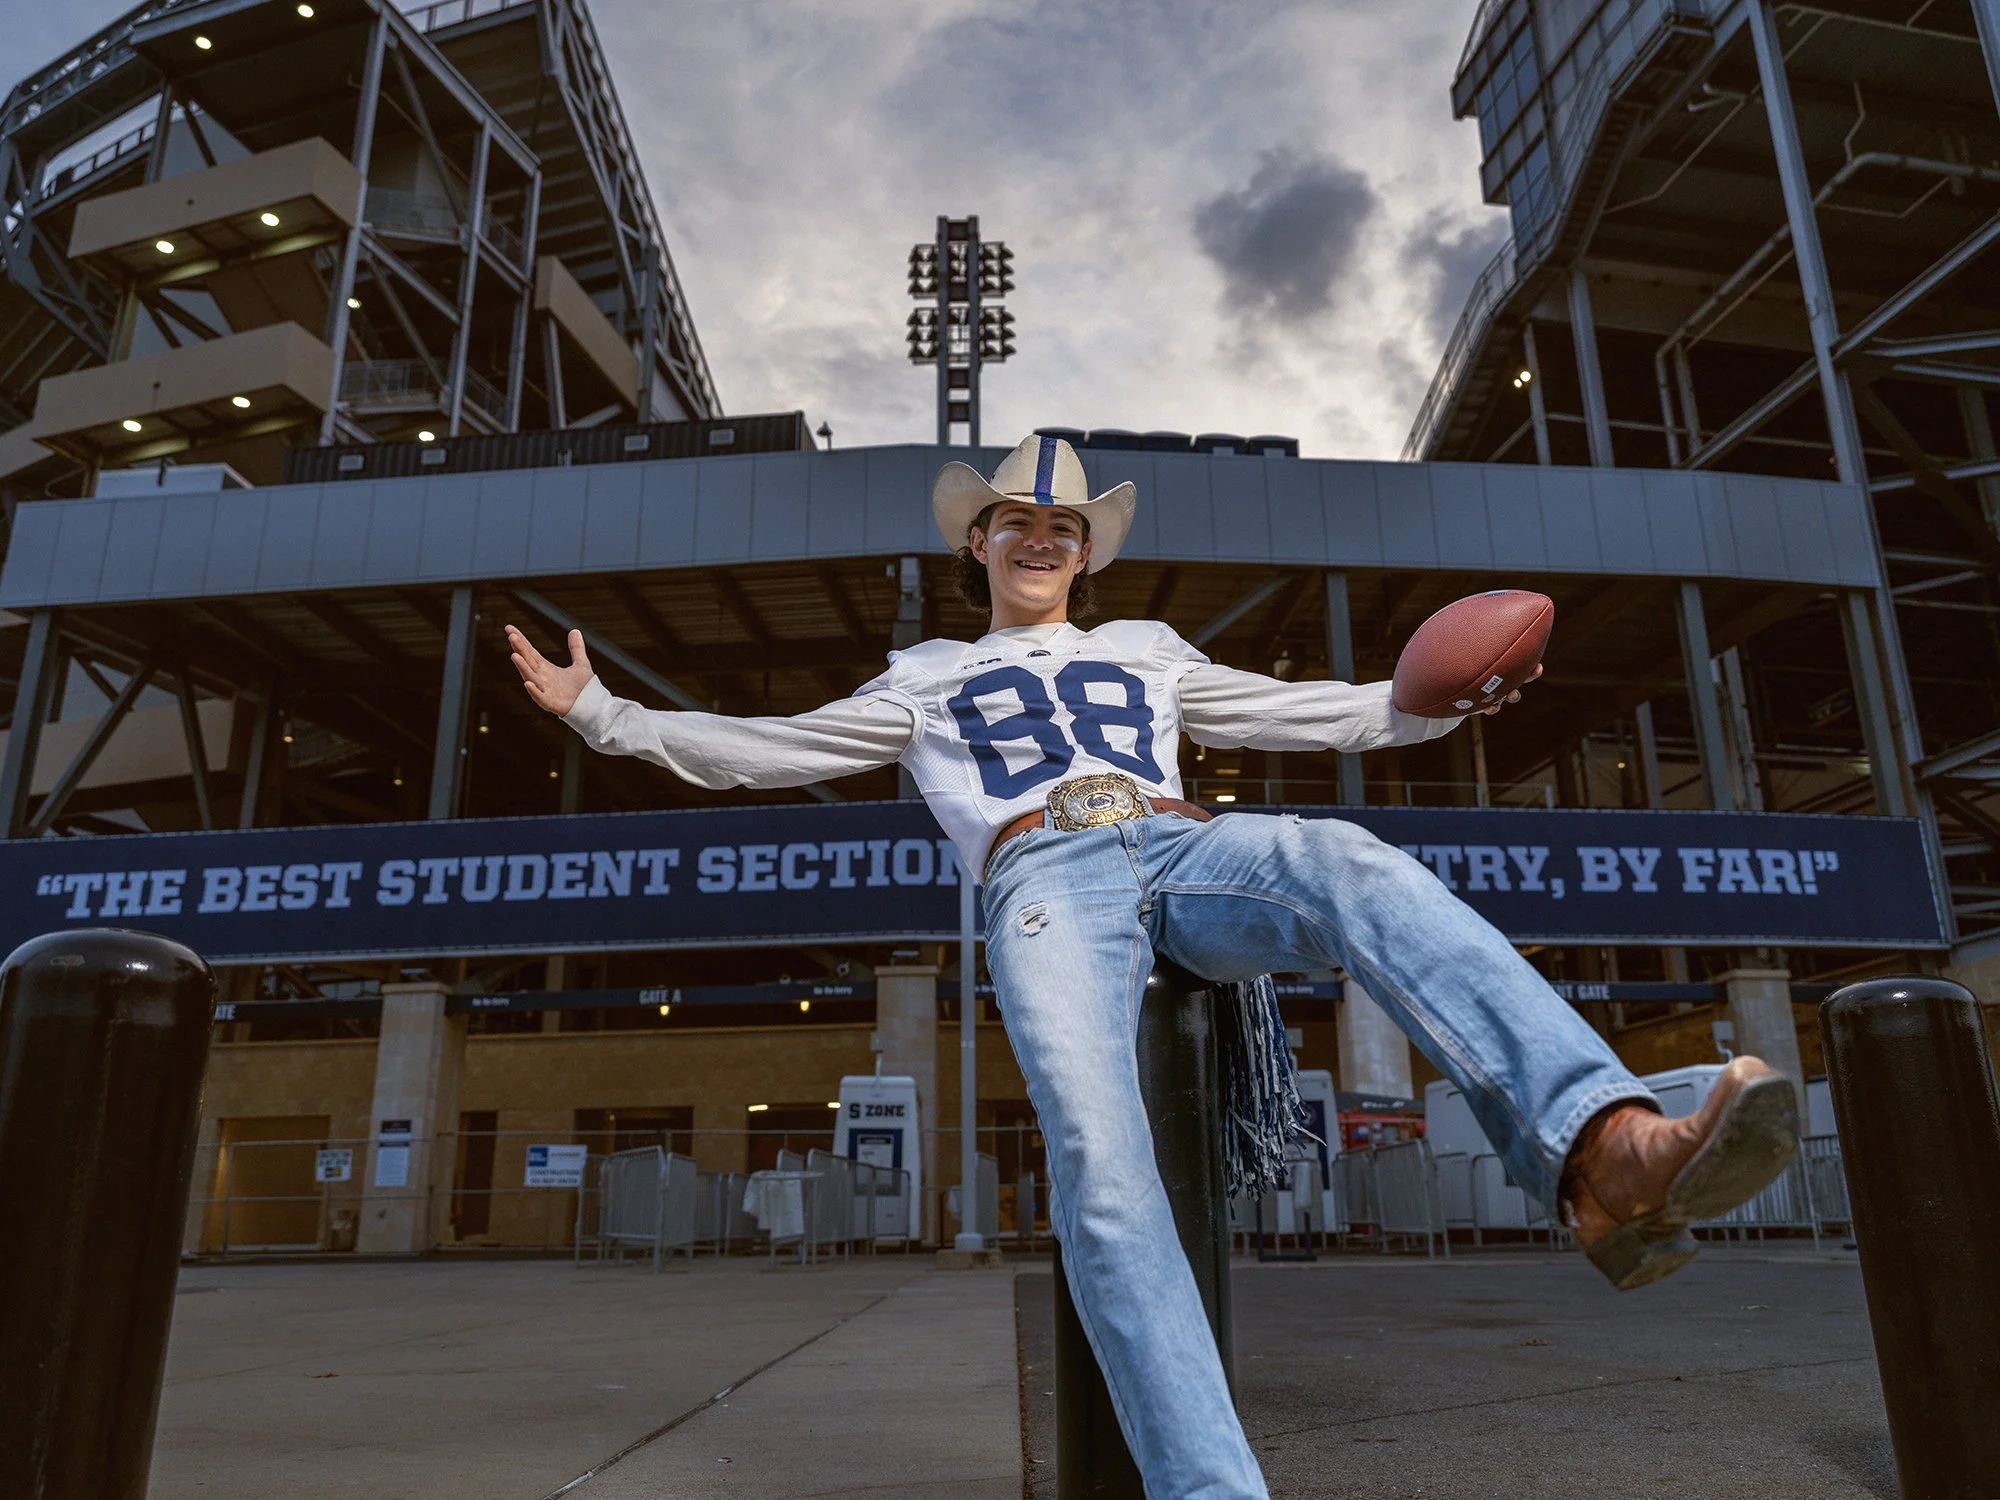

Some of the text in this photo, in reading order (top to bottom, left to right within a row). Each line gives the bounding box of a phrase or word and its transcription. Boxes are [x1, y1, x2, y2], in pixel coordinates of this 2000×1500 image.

[946, 660, 1165, 800] 88
[37, 868, 187, 919] “THE
[198, 861, 362, 914] BEST
[376, 848, 680, 906] STUDENT
[1400, 844, 1565, 899] TRY,
[1576, 846, 1661, 893] BY
[1677, 847, 1838, 895] FAR!”
[638, 988, 669, 1005] GATE
[214, 1003, 237, 1020] ATE
[849, 1103, 905, 1119] S ZONE
